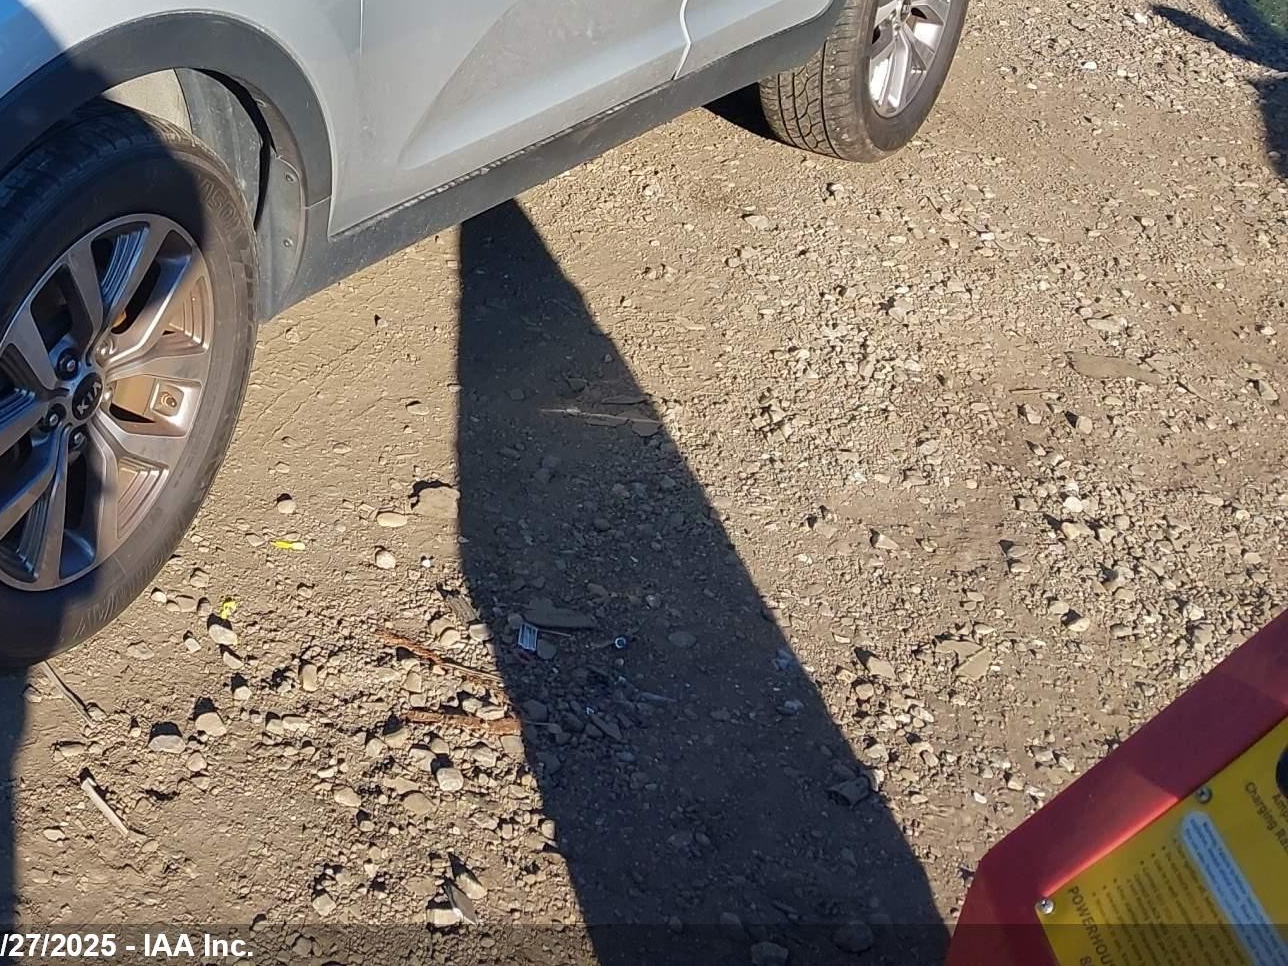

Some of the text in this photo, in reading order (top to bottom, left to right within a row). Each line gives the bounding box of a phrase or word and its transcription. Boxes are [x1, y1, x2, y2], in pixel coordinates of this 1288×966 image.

[76, 381, 102, 415] KIA
[1245, 781, 1277, 831] Charging
[1067, 886, 1114, 966] POWERHOU
